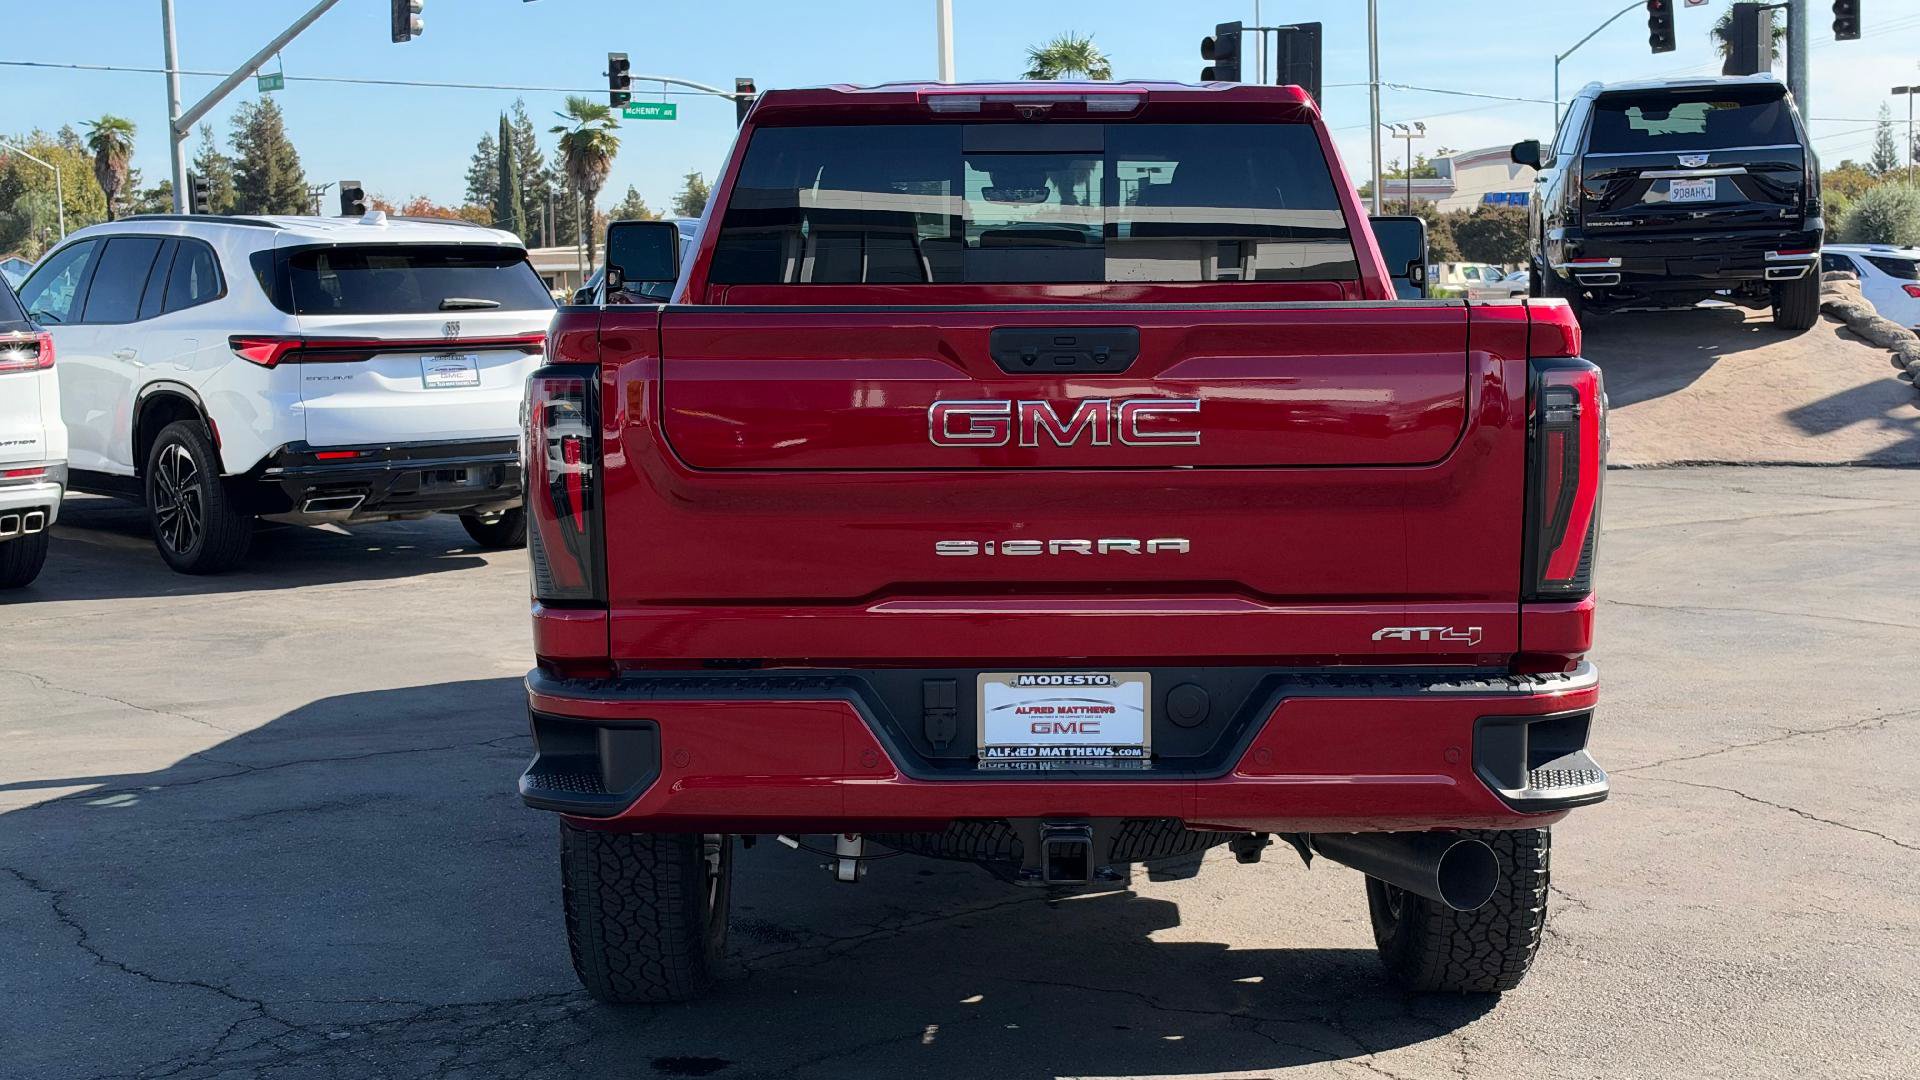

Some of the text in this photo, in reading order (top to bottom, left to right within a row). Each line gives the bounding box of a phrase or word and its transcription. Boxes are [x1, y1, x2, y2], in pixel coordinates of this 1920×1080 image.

[626, 107, 660, 115] McHENRY
[928, 398, 1201, 447] GMC
[935, 538, 1190, 556] SIERRA
[1371, 627, 1482, 646] AT4
[1019, 675, 1109, 685] MODESTO
[1015, 706, 1116, 714] ALFRED MATTHEWS
[1030, 721, 1101, 735] GMC
